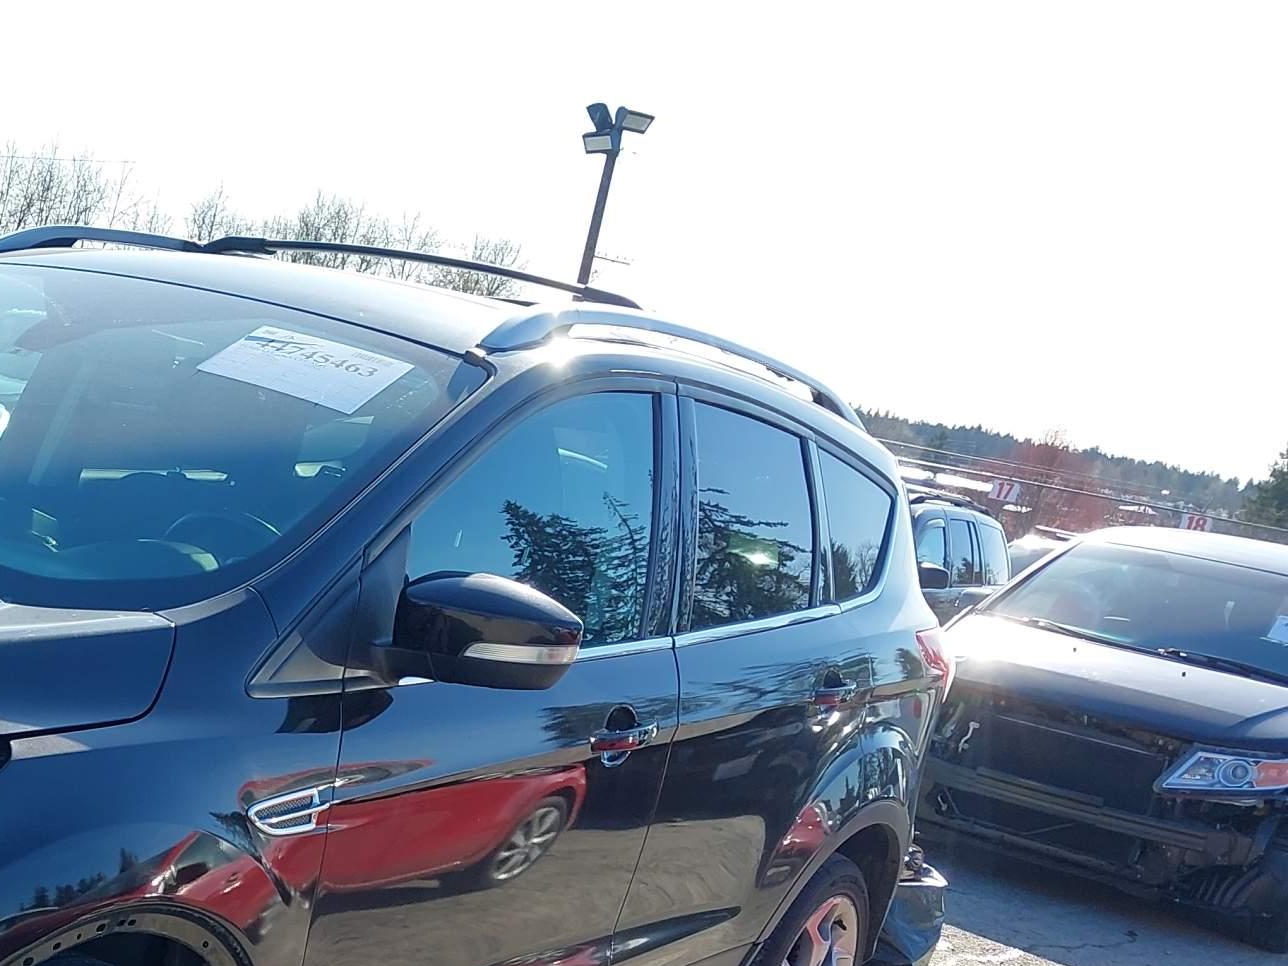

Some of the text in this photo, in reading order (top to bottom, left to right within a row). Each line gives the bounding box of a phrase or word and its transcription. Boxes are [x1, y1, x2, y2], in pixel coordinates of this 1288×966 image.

[255, 339, 379, 377] 44745463
[996, 481, 1015, 500] 17
[1186, 515, 1208, 531] 18
